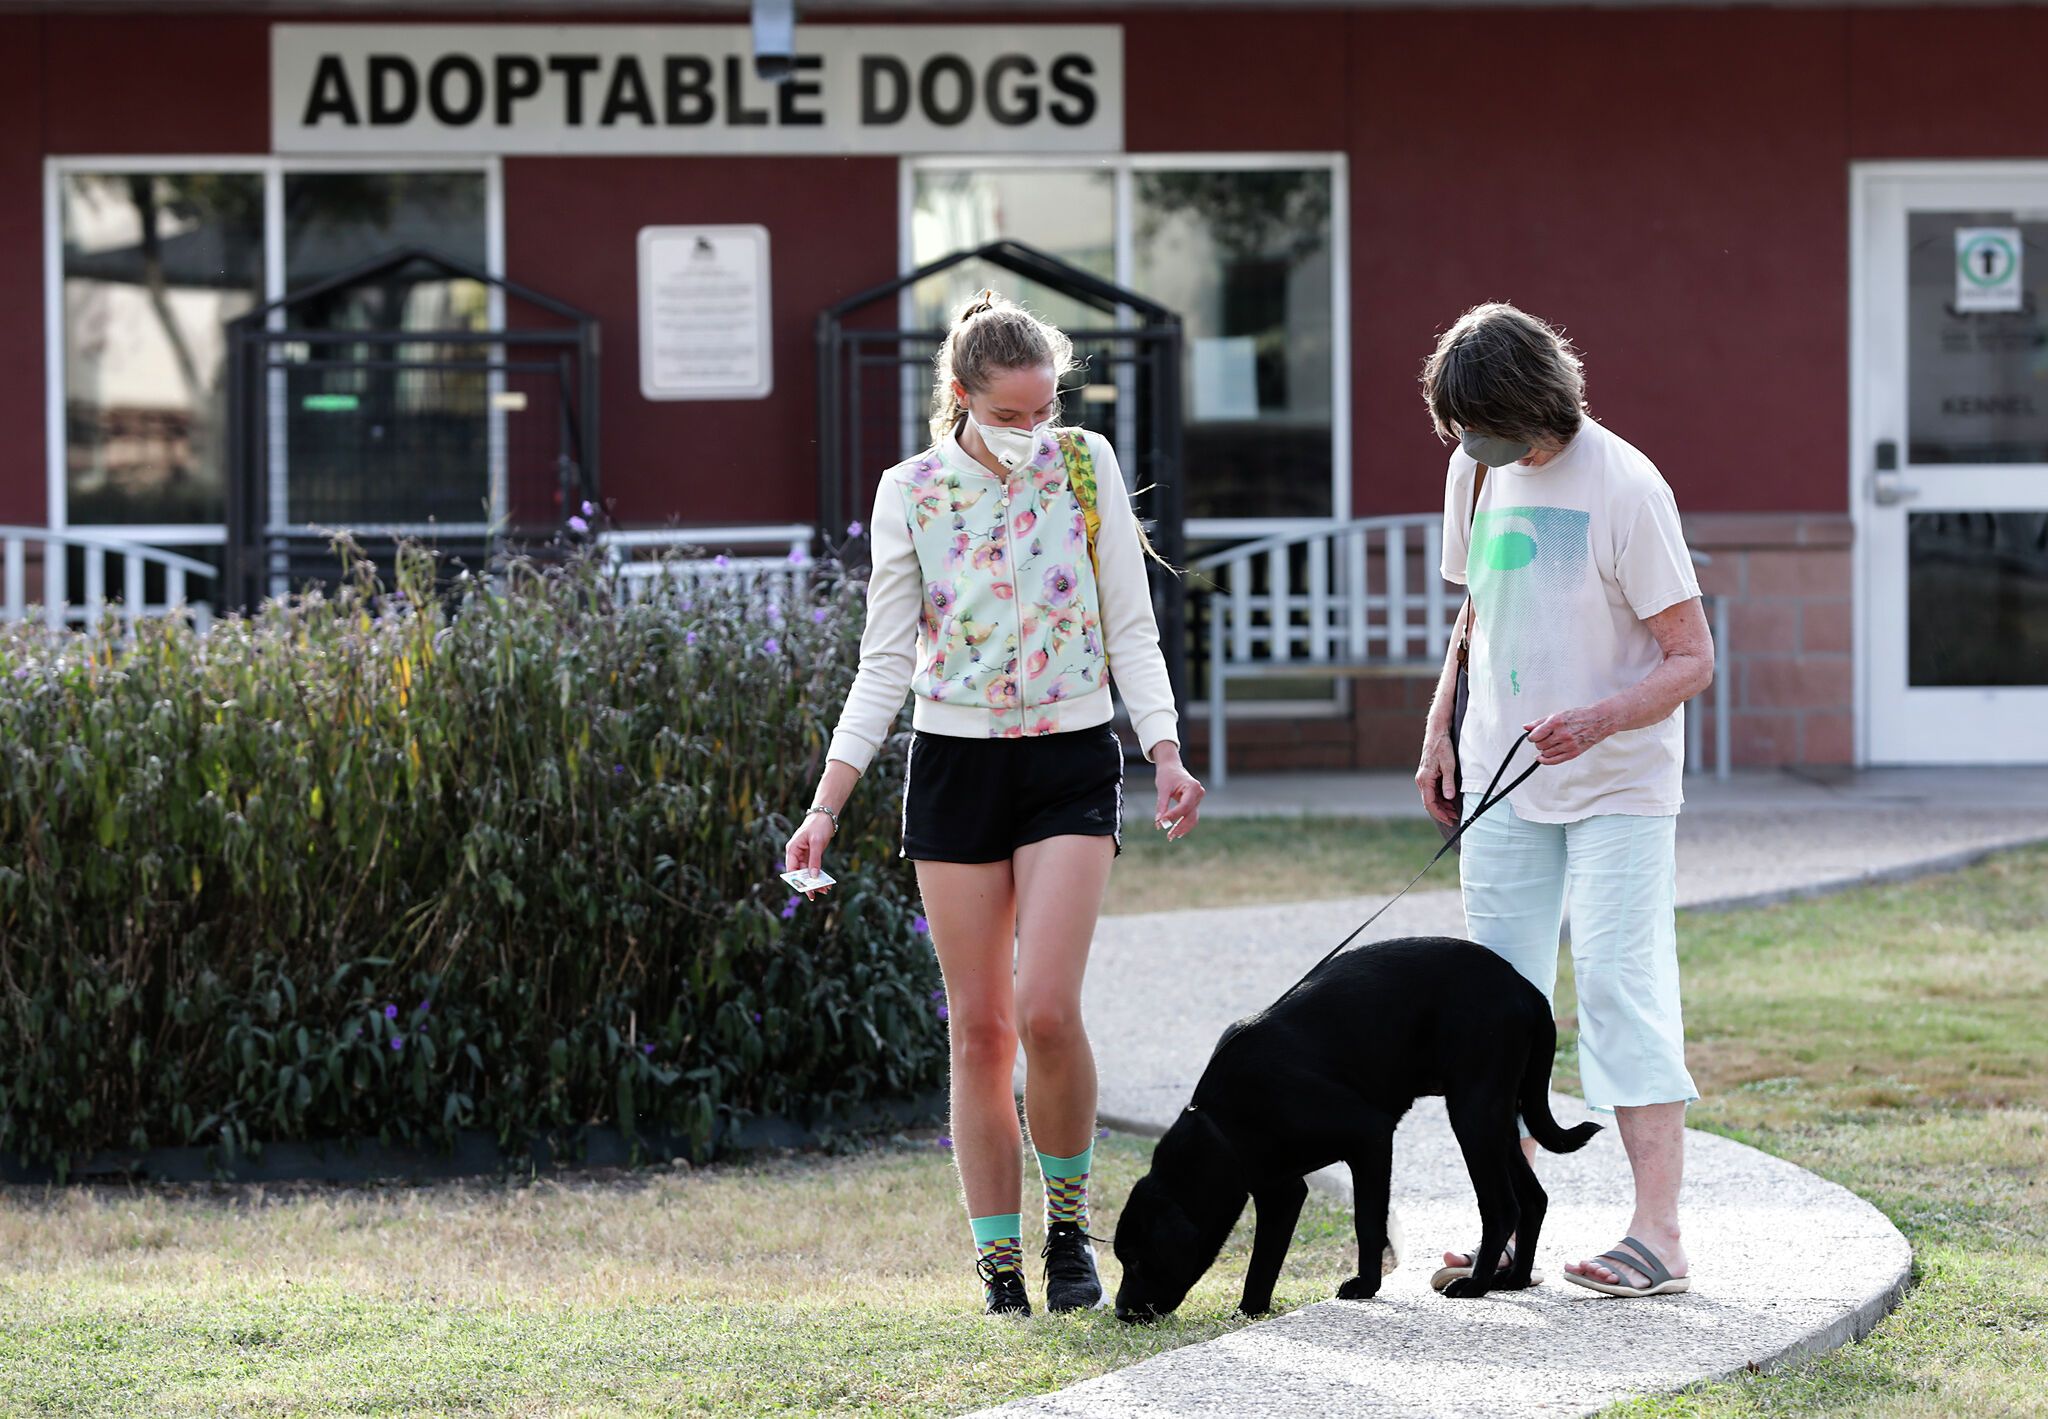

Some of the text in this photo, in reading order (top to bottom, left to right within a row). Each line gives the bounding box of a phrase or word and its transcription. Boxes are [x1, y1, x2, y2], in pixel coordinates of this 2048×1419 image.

[303, 53, 1099, 128] ADOPTABLE DOGS
[1941, 397, 2036, 417] KENNEL
